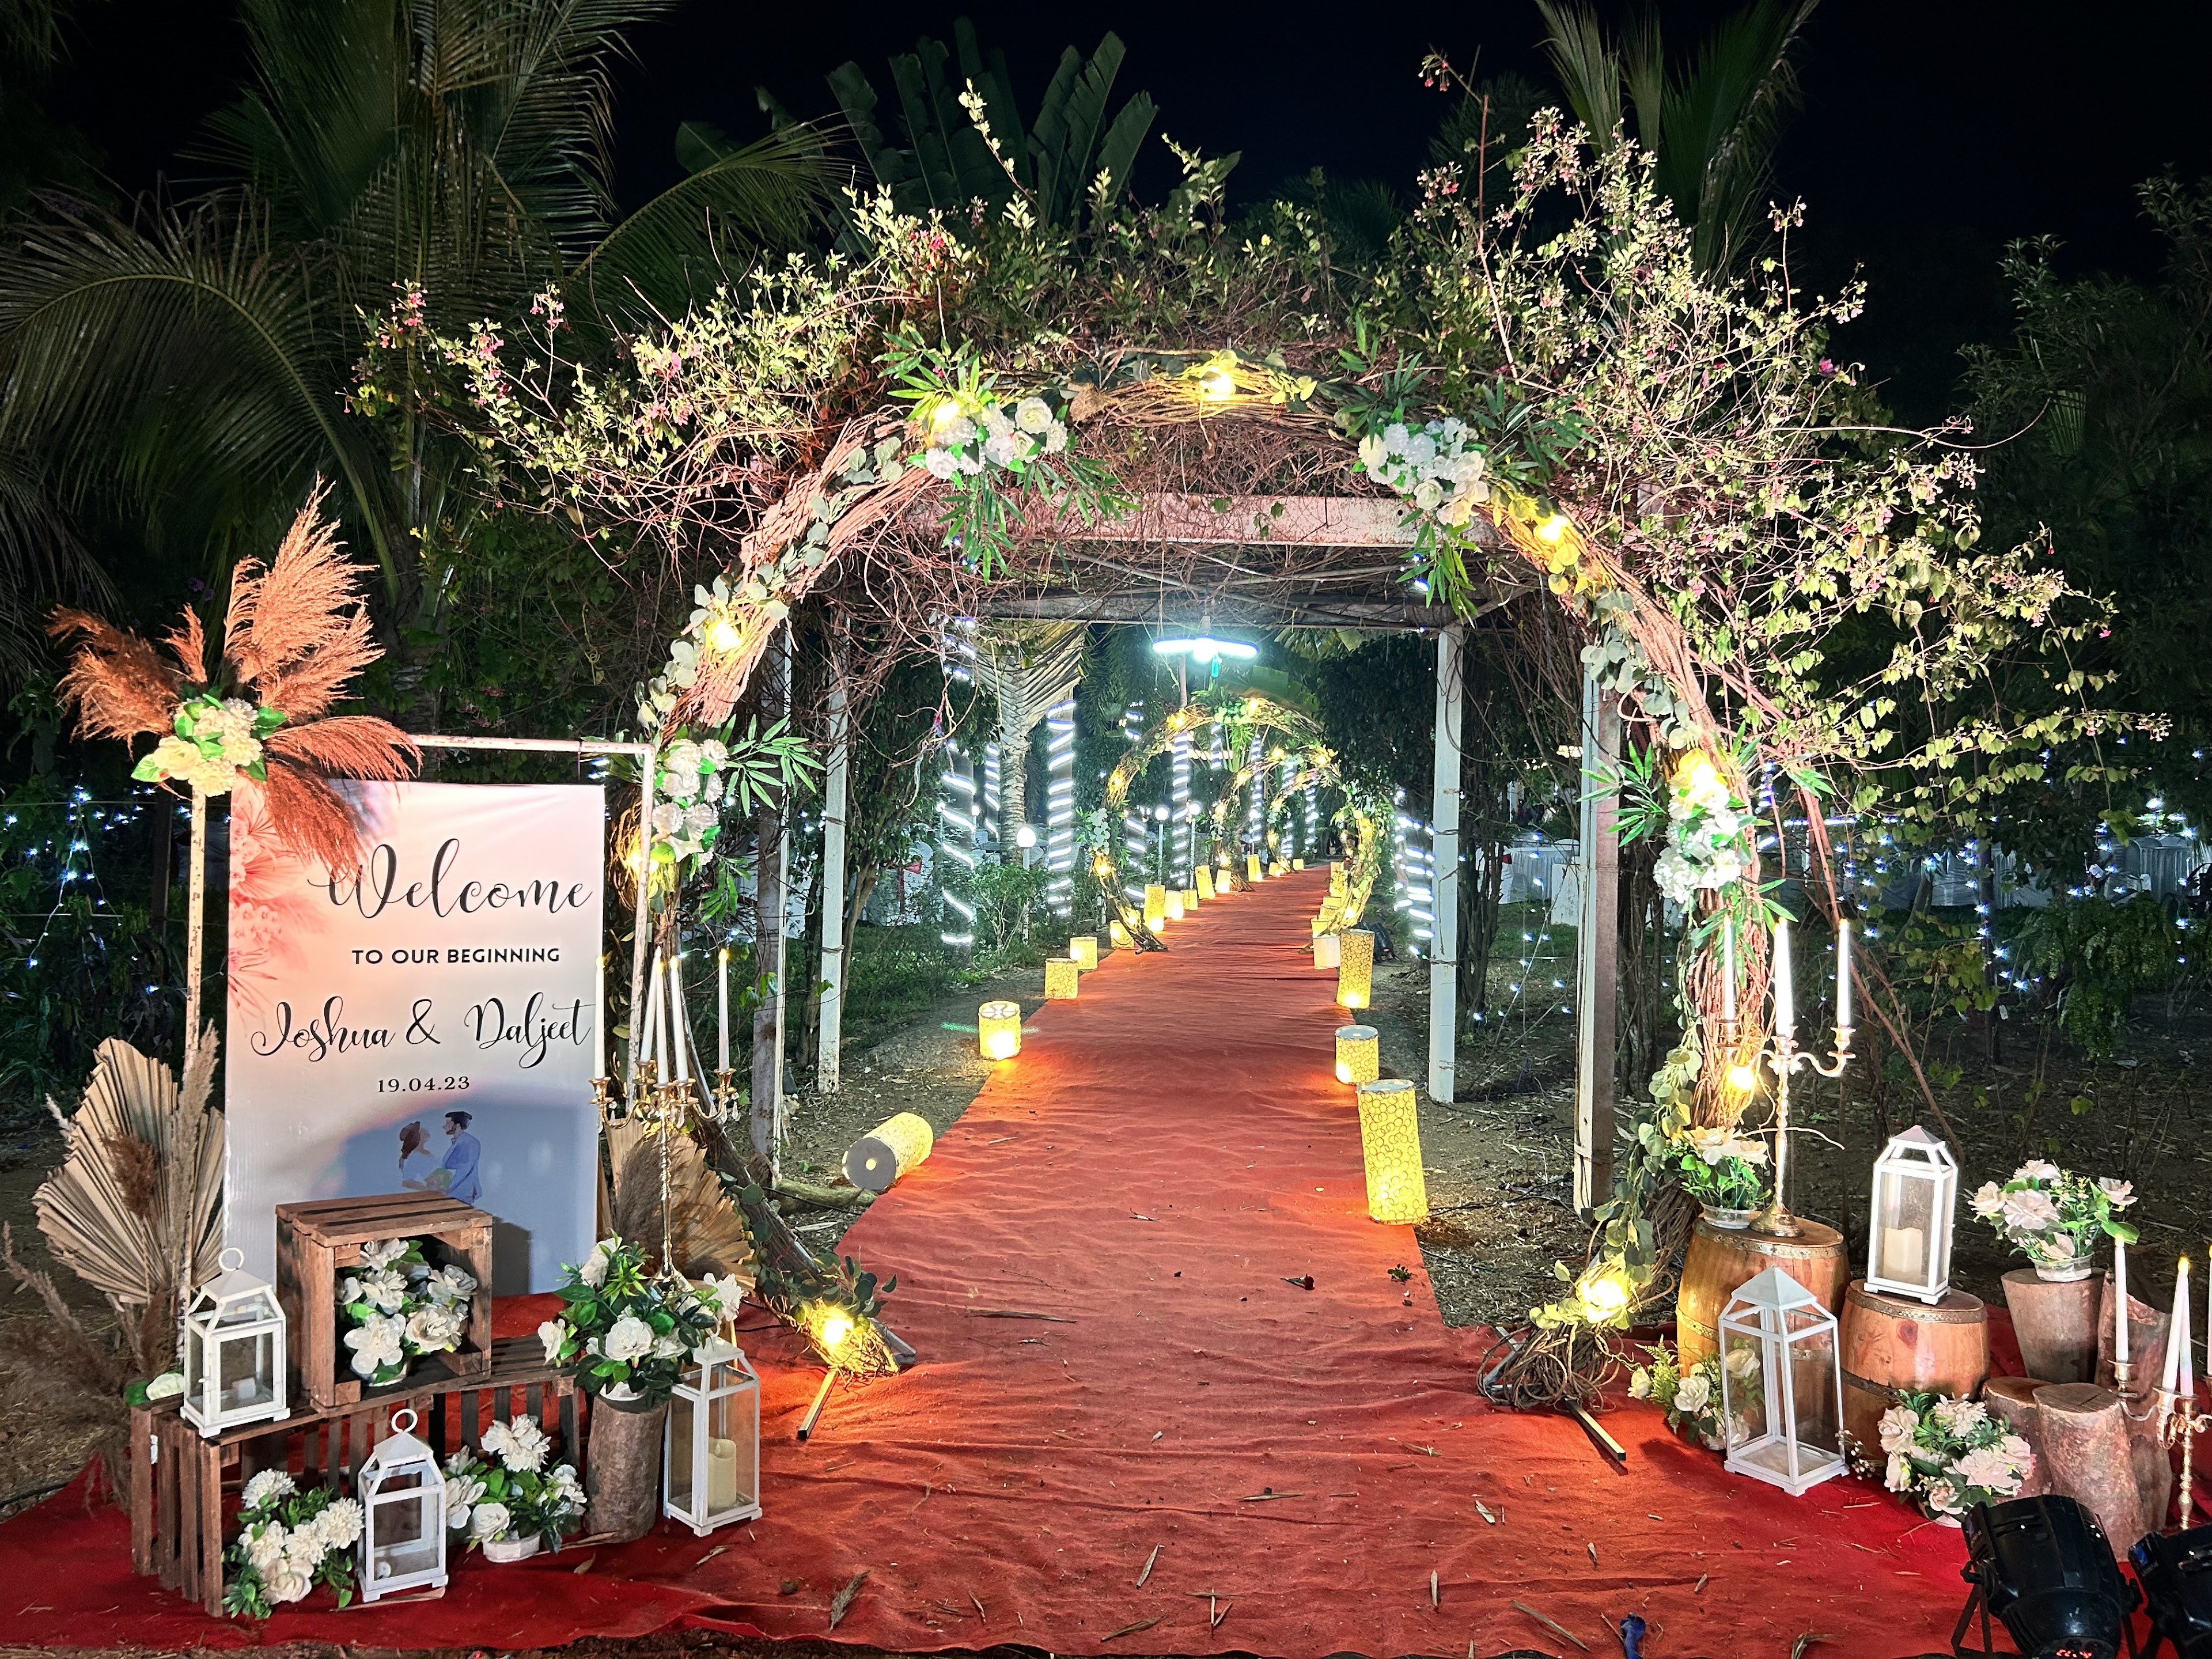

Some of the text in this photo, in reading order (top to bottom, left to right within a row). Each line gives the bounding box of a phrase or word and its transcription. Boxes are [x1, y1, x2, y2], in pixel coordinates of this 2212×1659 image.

[307, 838, 592, 919] Welcome
[352, 948, 560, 964] TO OUR BEGINNING
[251, 992, 596, 1069] Joshua & Daljeet
[378, 1075, 471, 1093] 19.04.23
